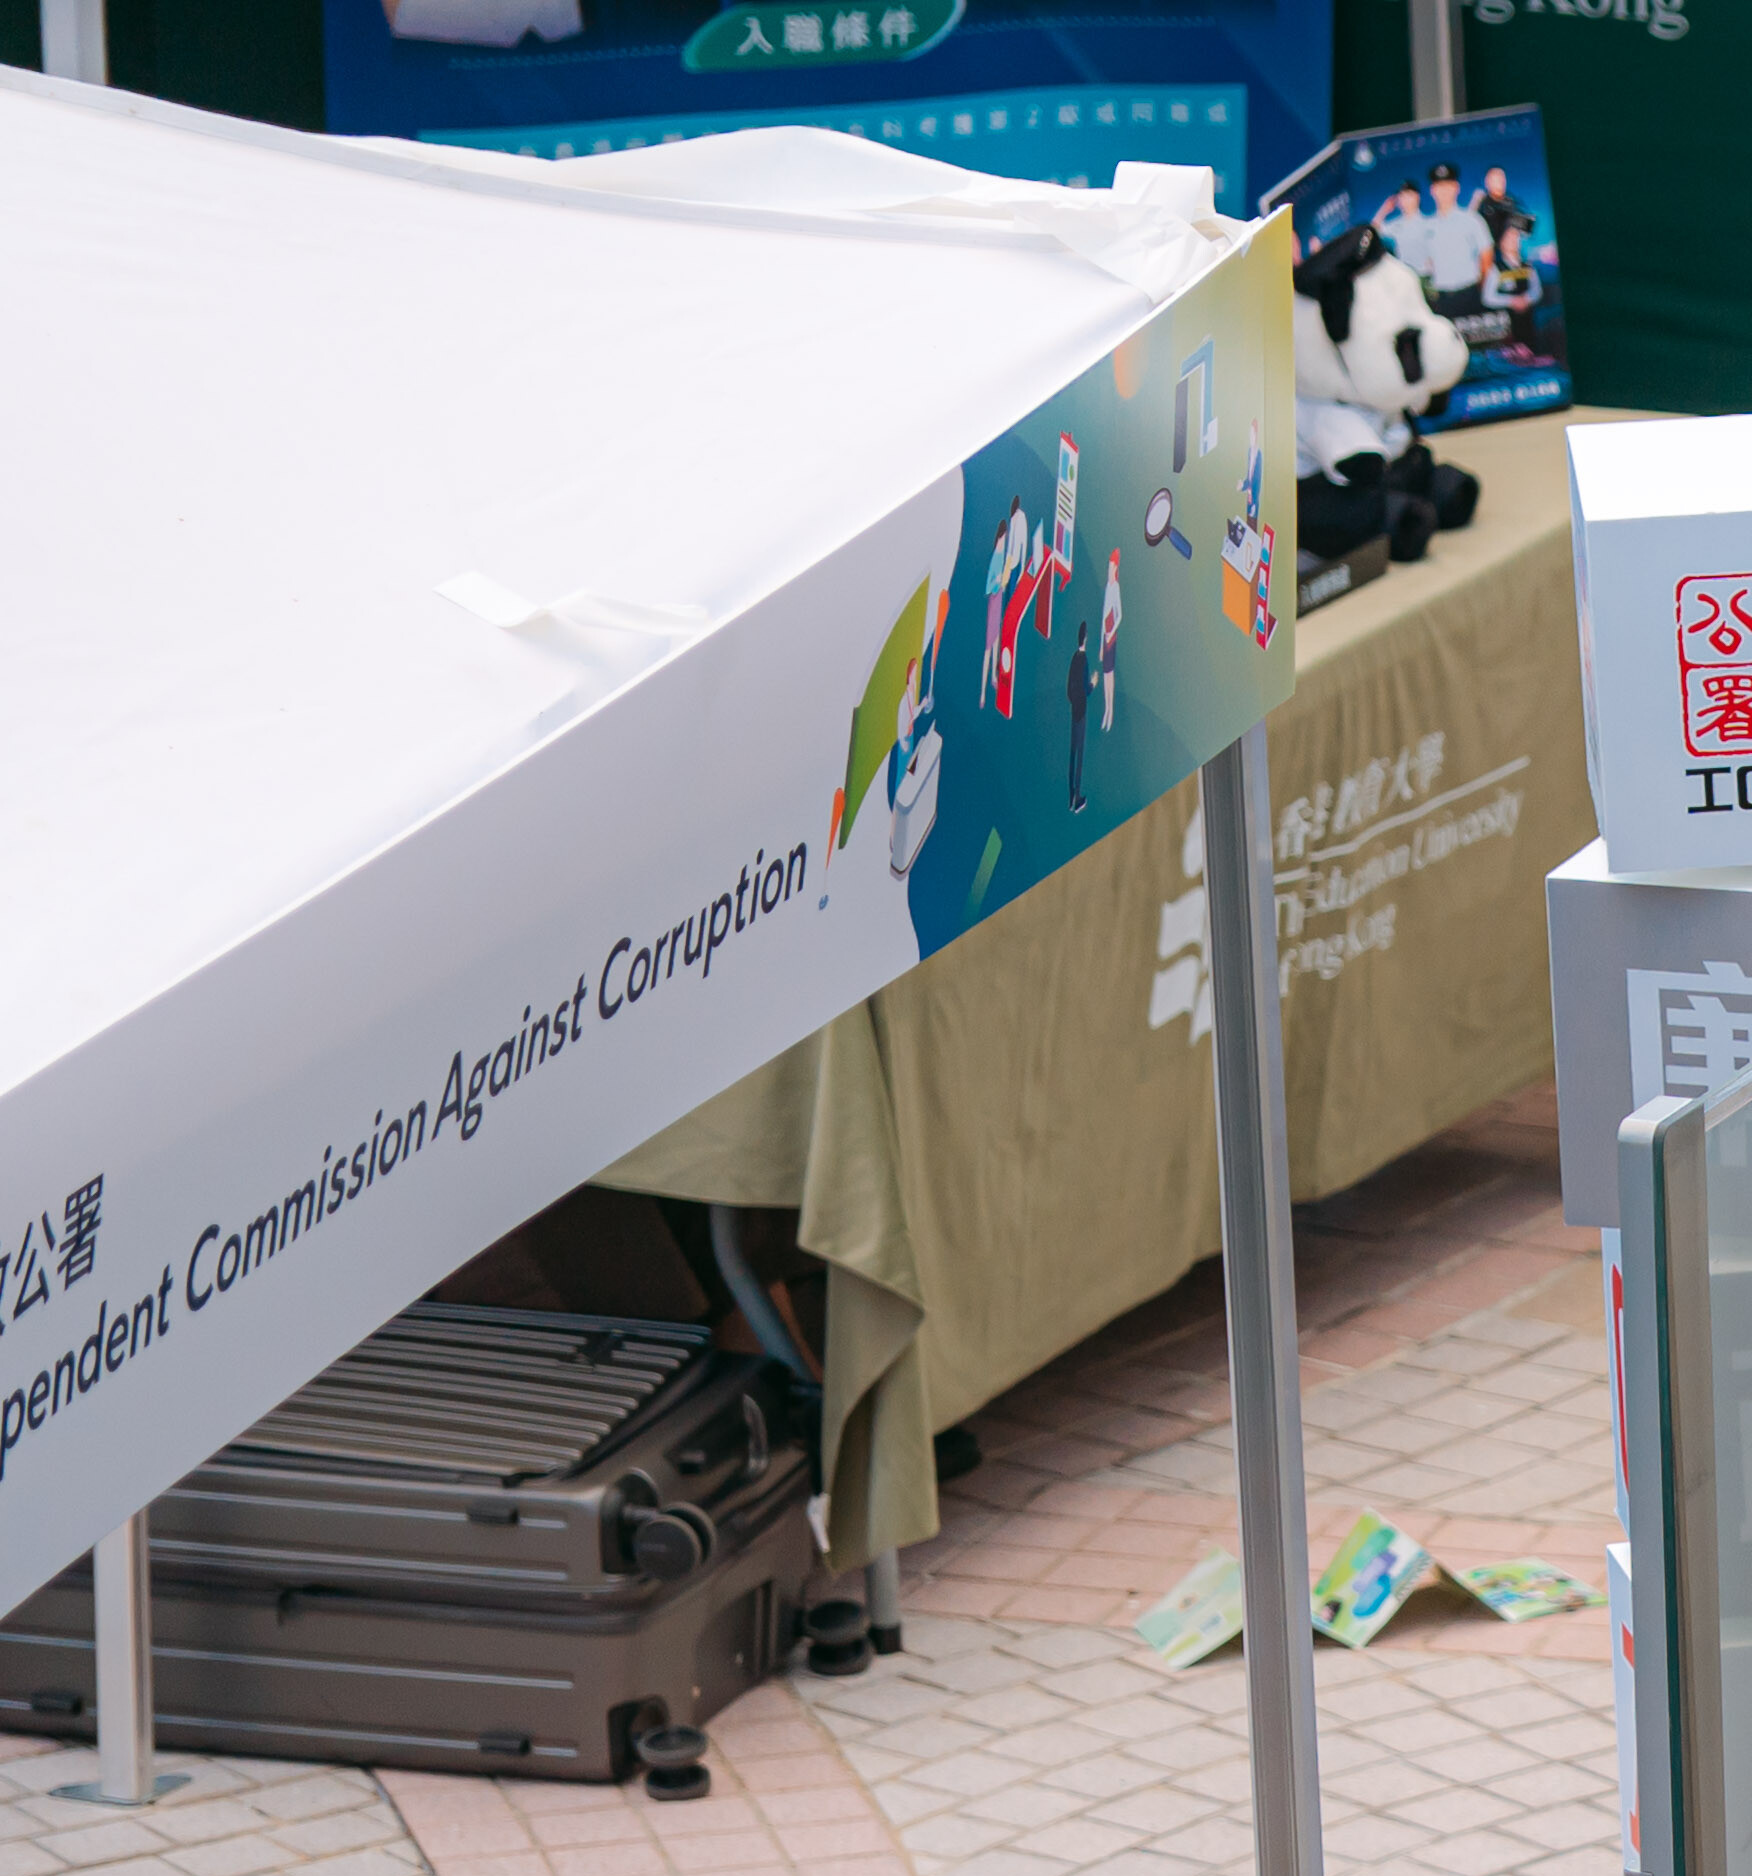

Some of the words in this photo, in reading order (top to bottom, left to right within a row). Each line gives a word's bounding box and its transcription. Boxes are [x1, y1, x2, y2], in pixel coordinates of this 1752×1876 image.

[736, 8, 918, 56] 入職條件
[185, 1099, 427, 1313] Commission
[431, 972, 586, 1143] Against
[597, 841, 807, 1021] Corruption
[0, 1172, 104, 1337] 公署
